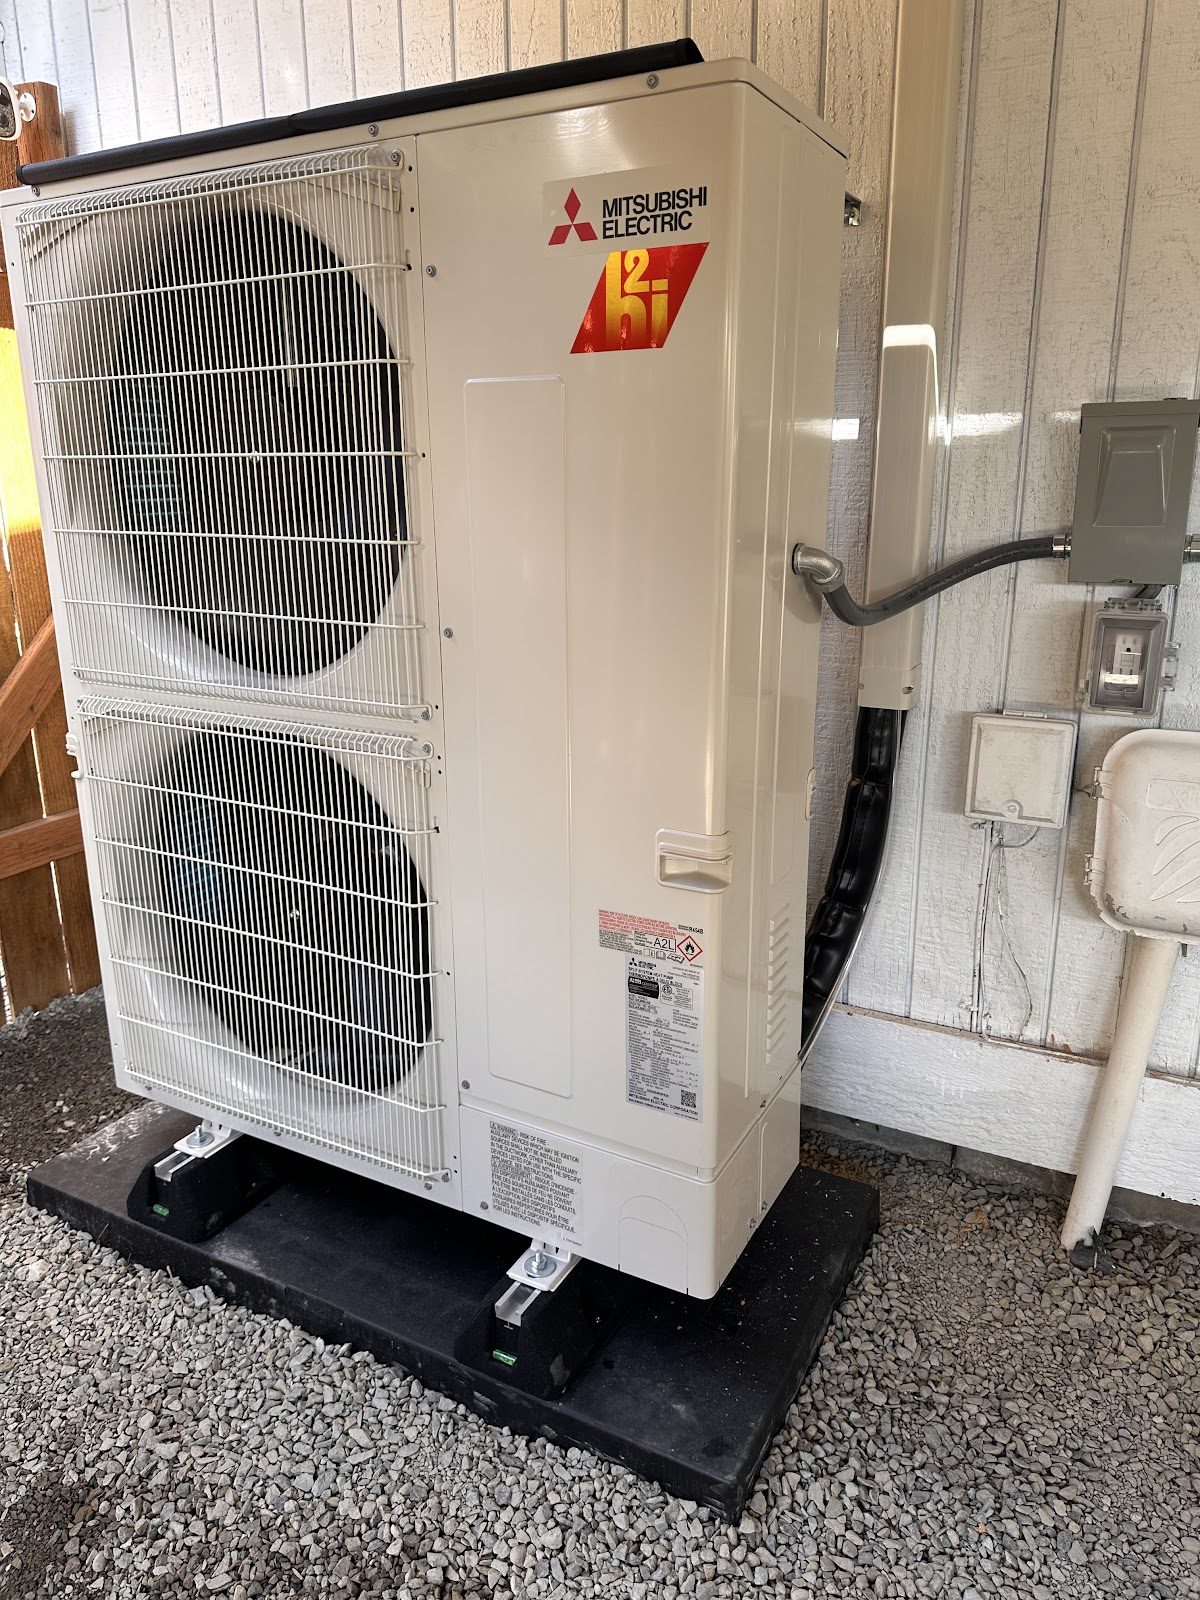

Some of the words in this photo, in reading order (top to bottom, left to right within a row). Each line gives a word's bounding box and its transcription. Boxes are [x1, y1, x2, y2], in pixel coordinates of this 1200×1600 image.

[602, 186, 708, 219] MITSUBISHI
[602, 210, 693, 239] ELECTRIC
[653, 937, 675, 951] A2L
[491, 1135, 510, 1146] SOURCES
[511, 1142, 522, 1150] SHALL
[524, 1146, 532, 1154] NOT
[540, 1152, 561, 1164] INSTALLED
[512, 1136, 528, 1146] DEVICES
[530, 1142, 543, 1151] WHICH
[561, 1153, 579, 1163] IGNITION
[537, 1137, 546, 1145] FIRE
[491, 1148, 508, 1158] DEVICES
[509, 1154, 522, 1163] LISTED
[542, 1166, 552, 1174] WITH
[553, 1169, 561, 1177] THE
[562, 1173, 581, 1184] SPECIFIC
[529, 1155, 543, 1164] OTHER
[544, 1160, 555, 1168] THAN
[556, 1164, 578, 1176] AUXILIARY
[554, 1195, 572, 1206] DOIVENT
